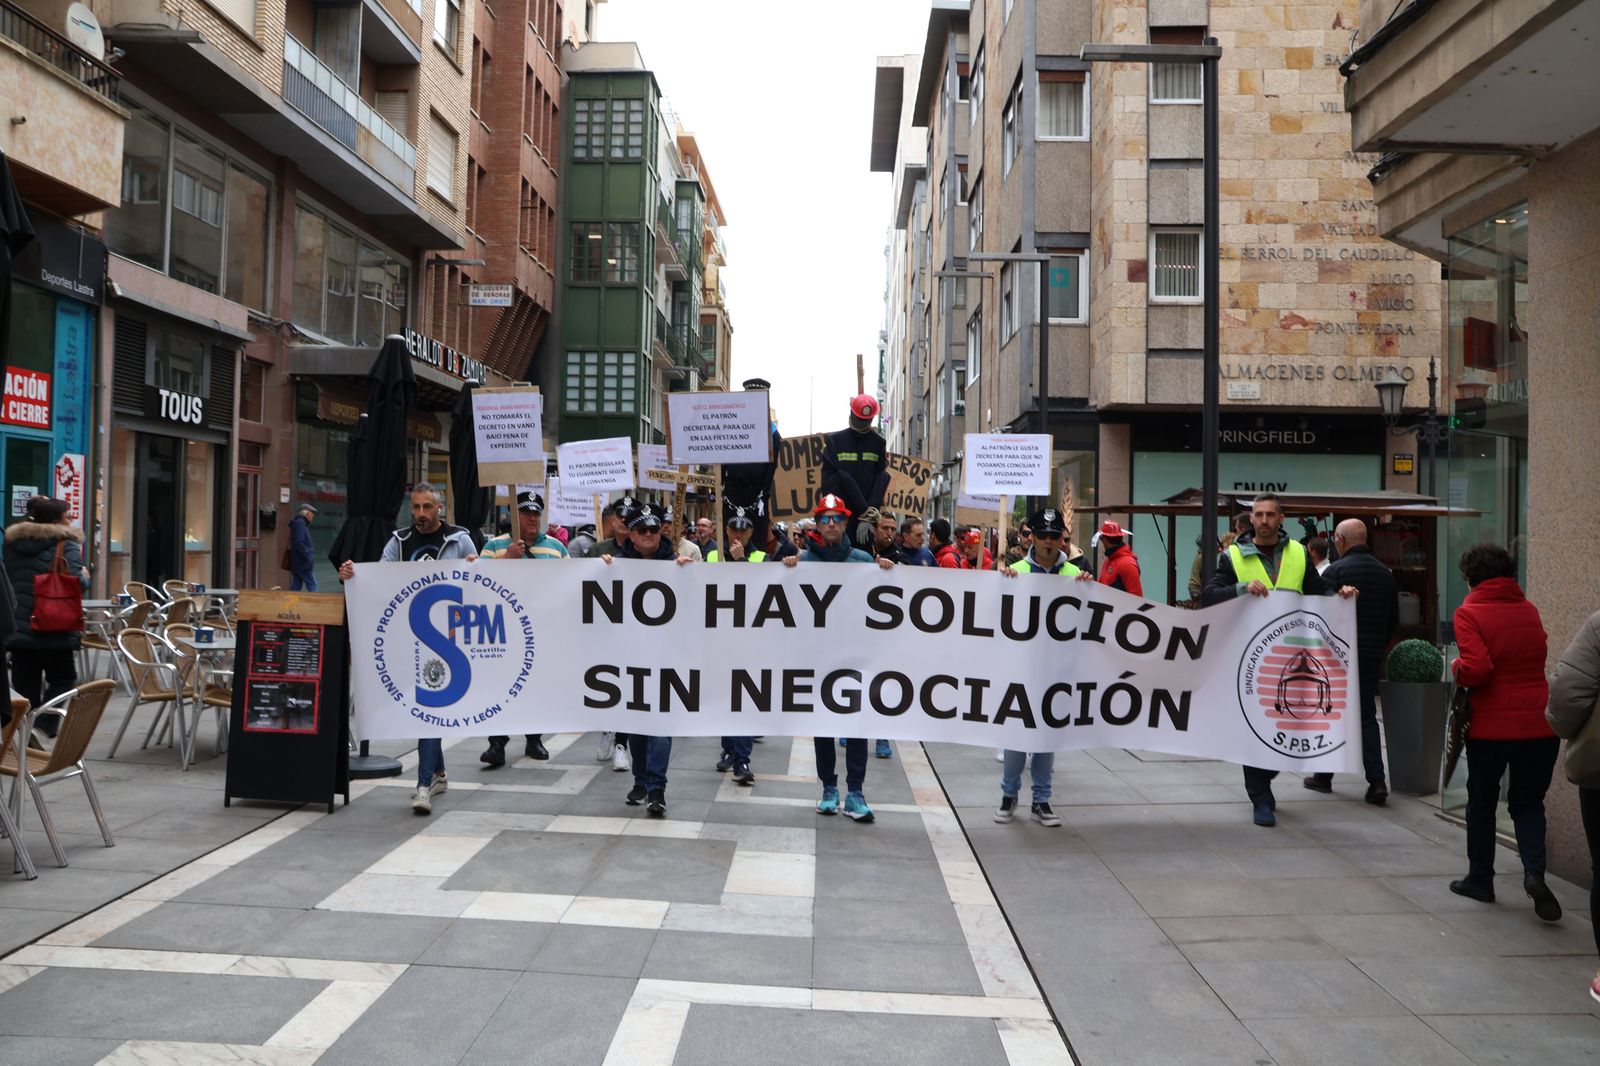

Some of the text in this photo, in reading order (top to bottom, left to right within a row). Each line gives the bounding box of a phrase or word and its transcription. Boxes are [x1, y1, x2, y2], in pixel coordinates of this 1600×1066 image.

[1303, 248, 1334, 261] DEL
[1339, 248, 1415, 261] CAUDILLO
[41, 268, 95, 298] Deportes Lastra
[1371, 273, 1415, 286] LUGO
[1375, 298, 1415, 311] VIGO
[1314, 322, 1416, 336] PONTEVEDRA
[405, 327, 445, 369] HERALDO
[1218, 363, 1325, 382] ALMACENES
[159, 388, 203, 425] TOUS
[9, 403, 49, 426] CIERRE
[493, 412, 523, 420] TOMARÁS
[711, 412, 738, 420] PATRÓN
[478, 423, 507, 431] DECRETO
[682, 423, 756, 432] DECRETARÁ PARA QUE
[690, 434, 700, 442] EN
[1217, 430, 1316, 444] PRINGFIELD
[490, 442, 527, 450] EXPEDIENTE
[688, 443, 753, 452] PUEDAS DESCANSAR
[568, 459, 626, 471] EL PATRÓN REGULARÁ
[576, 470, 608, 478] CUADRANTE
[609, 467, 628, 475] SEGÚN
[586, 478, 617, 486] CONVENGA
[452, 570, 470, 582] DE
[473, 573, 524, 614] POLICÍAS
[376, 571, 449, 634] PROFESIONAL
[581, 579, 1210, 662] NO HAY SOLUCIÓN
[508, 615, 535, 699] MUNICIPALES
[373, 637, 404, 702] SINDICATO
[1245, 645, 1264, 696] SINDICATO
[583, 664, 1193, 732] SIN NEGOCIACIÓN
[410, 707, 460, 728] CASTILLA
[463, 717, 472, 726] Y
[473, 703, 502, 724] LEÓN
[1273, 731, 1334, 753] S.P.B.Z.
